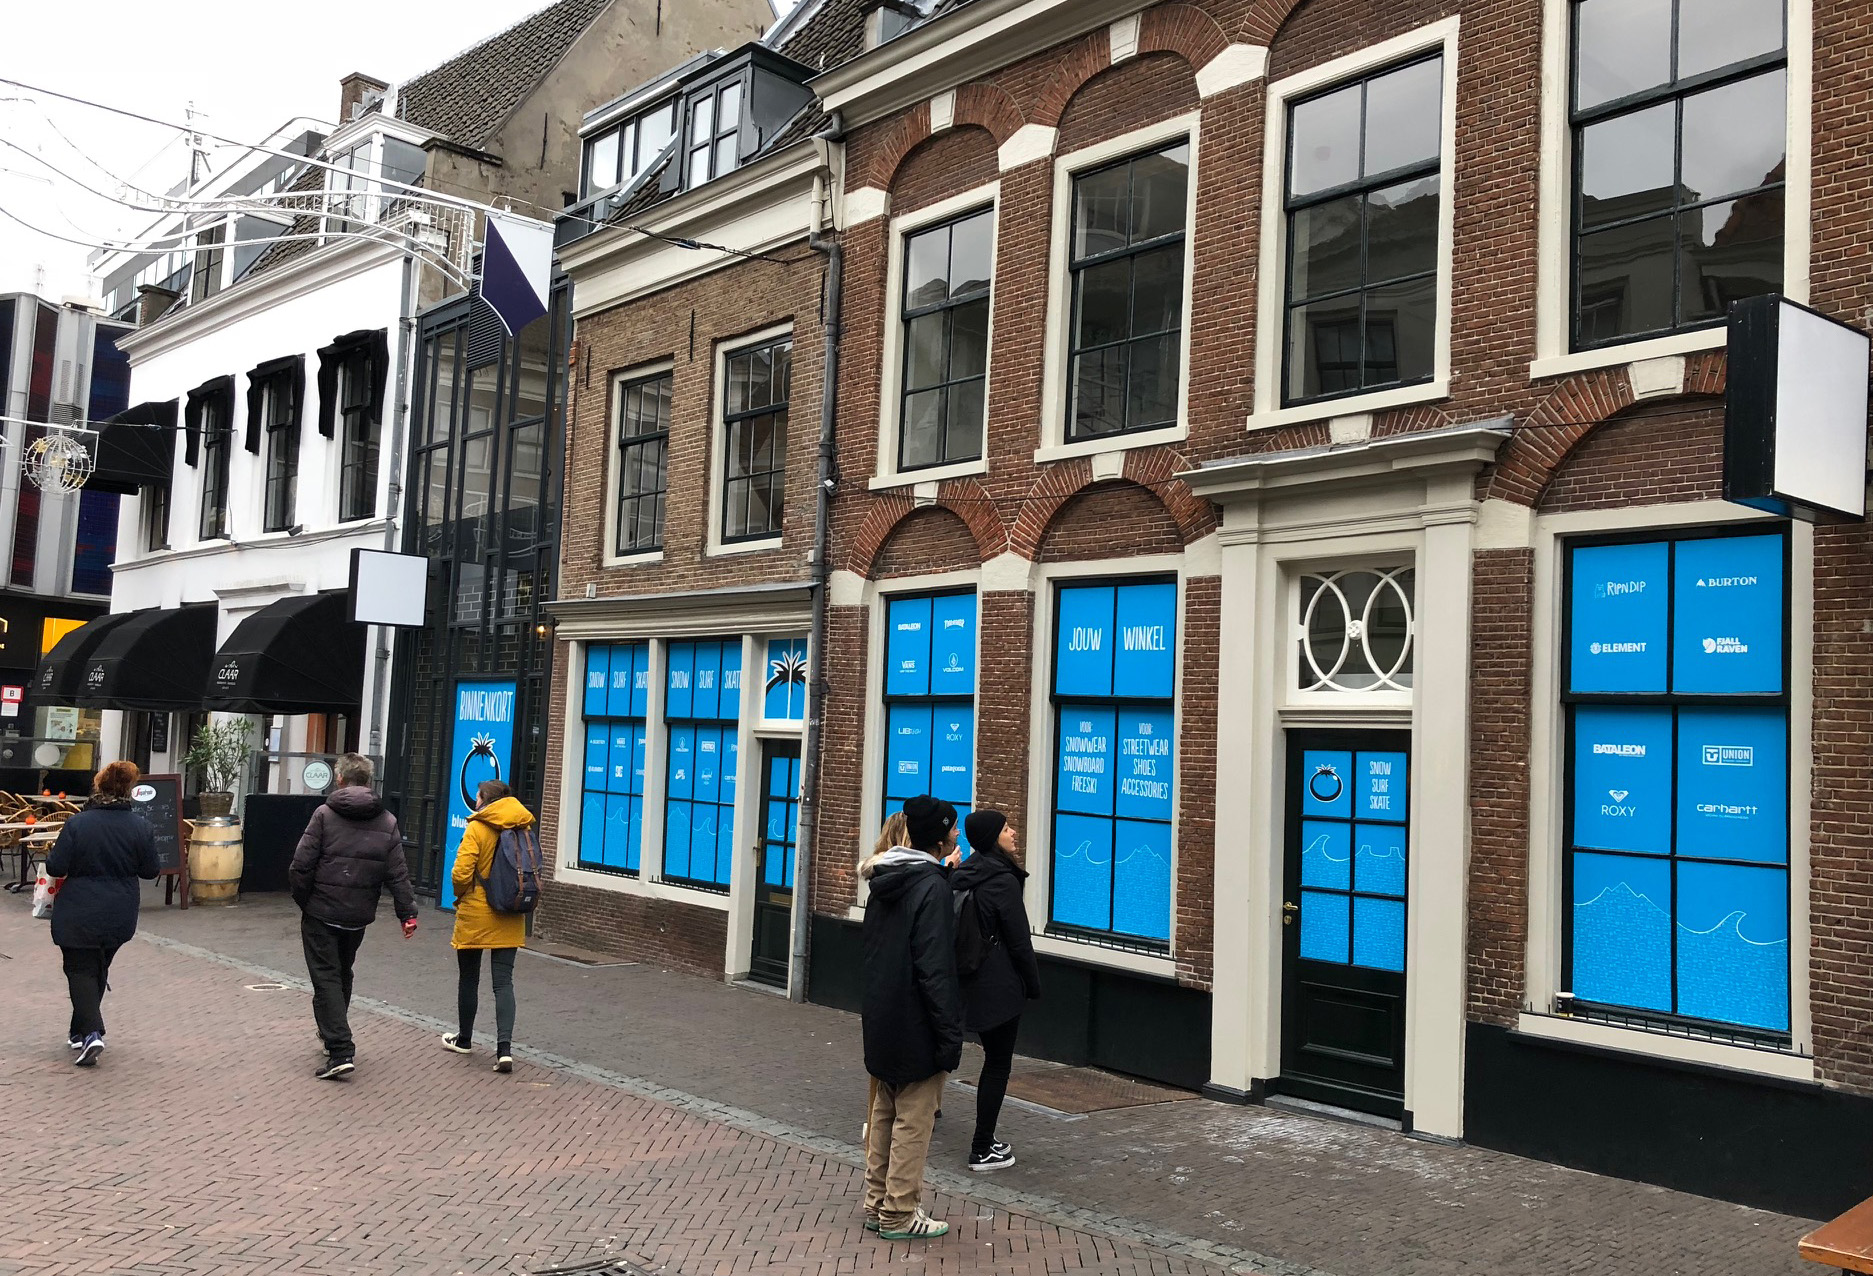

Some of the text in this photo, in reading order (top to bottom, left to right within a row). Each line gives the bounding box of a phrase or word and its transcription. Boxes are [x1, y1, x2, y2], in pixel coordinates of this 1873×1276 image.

[1709, 576, 1757, 587] BURTON
[1069, 625, 1166, 652] JOUW WINKEL
[1602, 642, 1647, 653] ELEMENT
[588, 671, 648, 689] SNOW SURF SKAT
[671, 670, 690, 689] SNOW
[699, 670, 715, 689] SURF
[459, 690, 514, 723] BINNENKORT
[946, 733, 963, 742] ROXY
[1065, 736, 1107, 753] SNOWWEAR
[1122, 738, 1169, 756] STREETWEAR
[1592, 743, 1646, 756] BATALEON
[1722, 749, 1750, 760] UNION
[1063, 755, 1105, 774] SNOWBOARD
[1133, 758, 1156, 777] SHOES
[1369, 760, 1392, 776] SNOW
[1071, 775, 1098, 794] FREESKI
[1120, 777, 1169, 800] ACCESSORIES
[1371, 778, 1389, 793] SURF
[1369, 795, 1391, 810] SKATE
[1601, 804, 1636, 817] ROXY
[1696, 803, 1759, 816] carhartt
